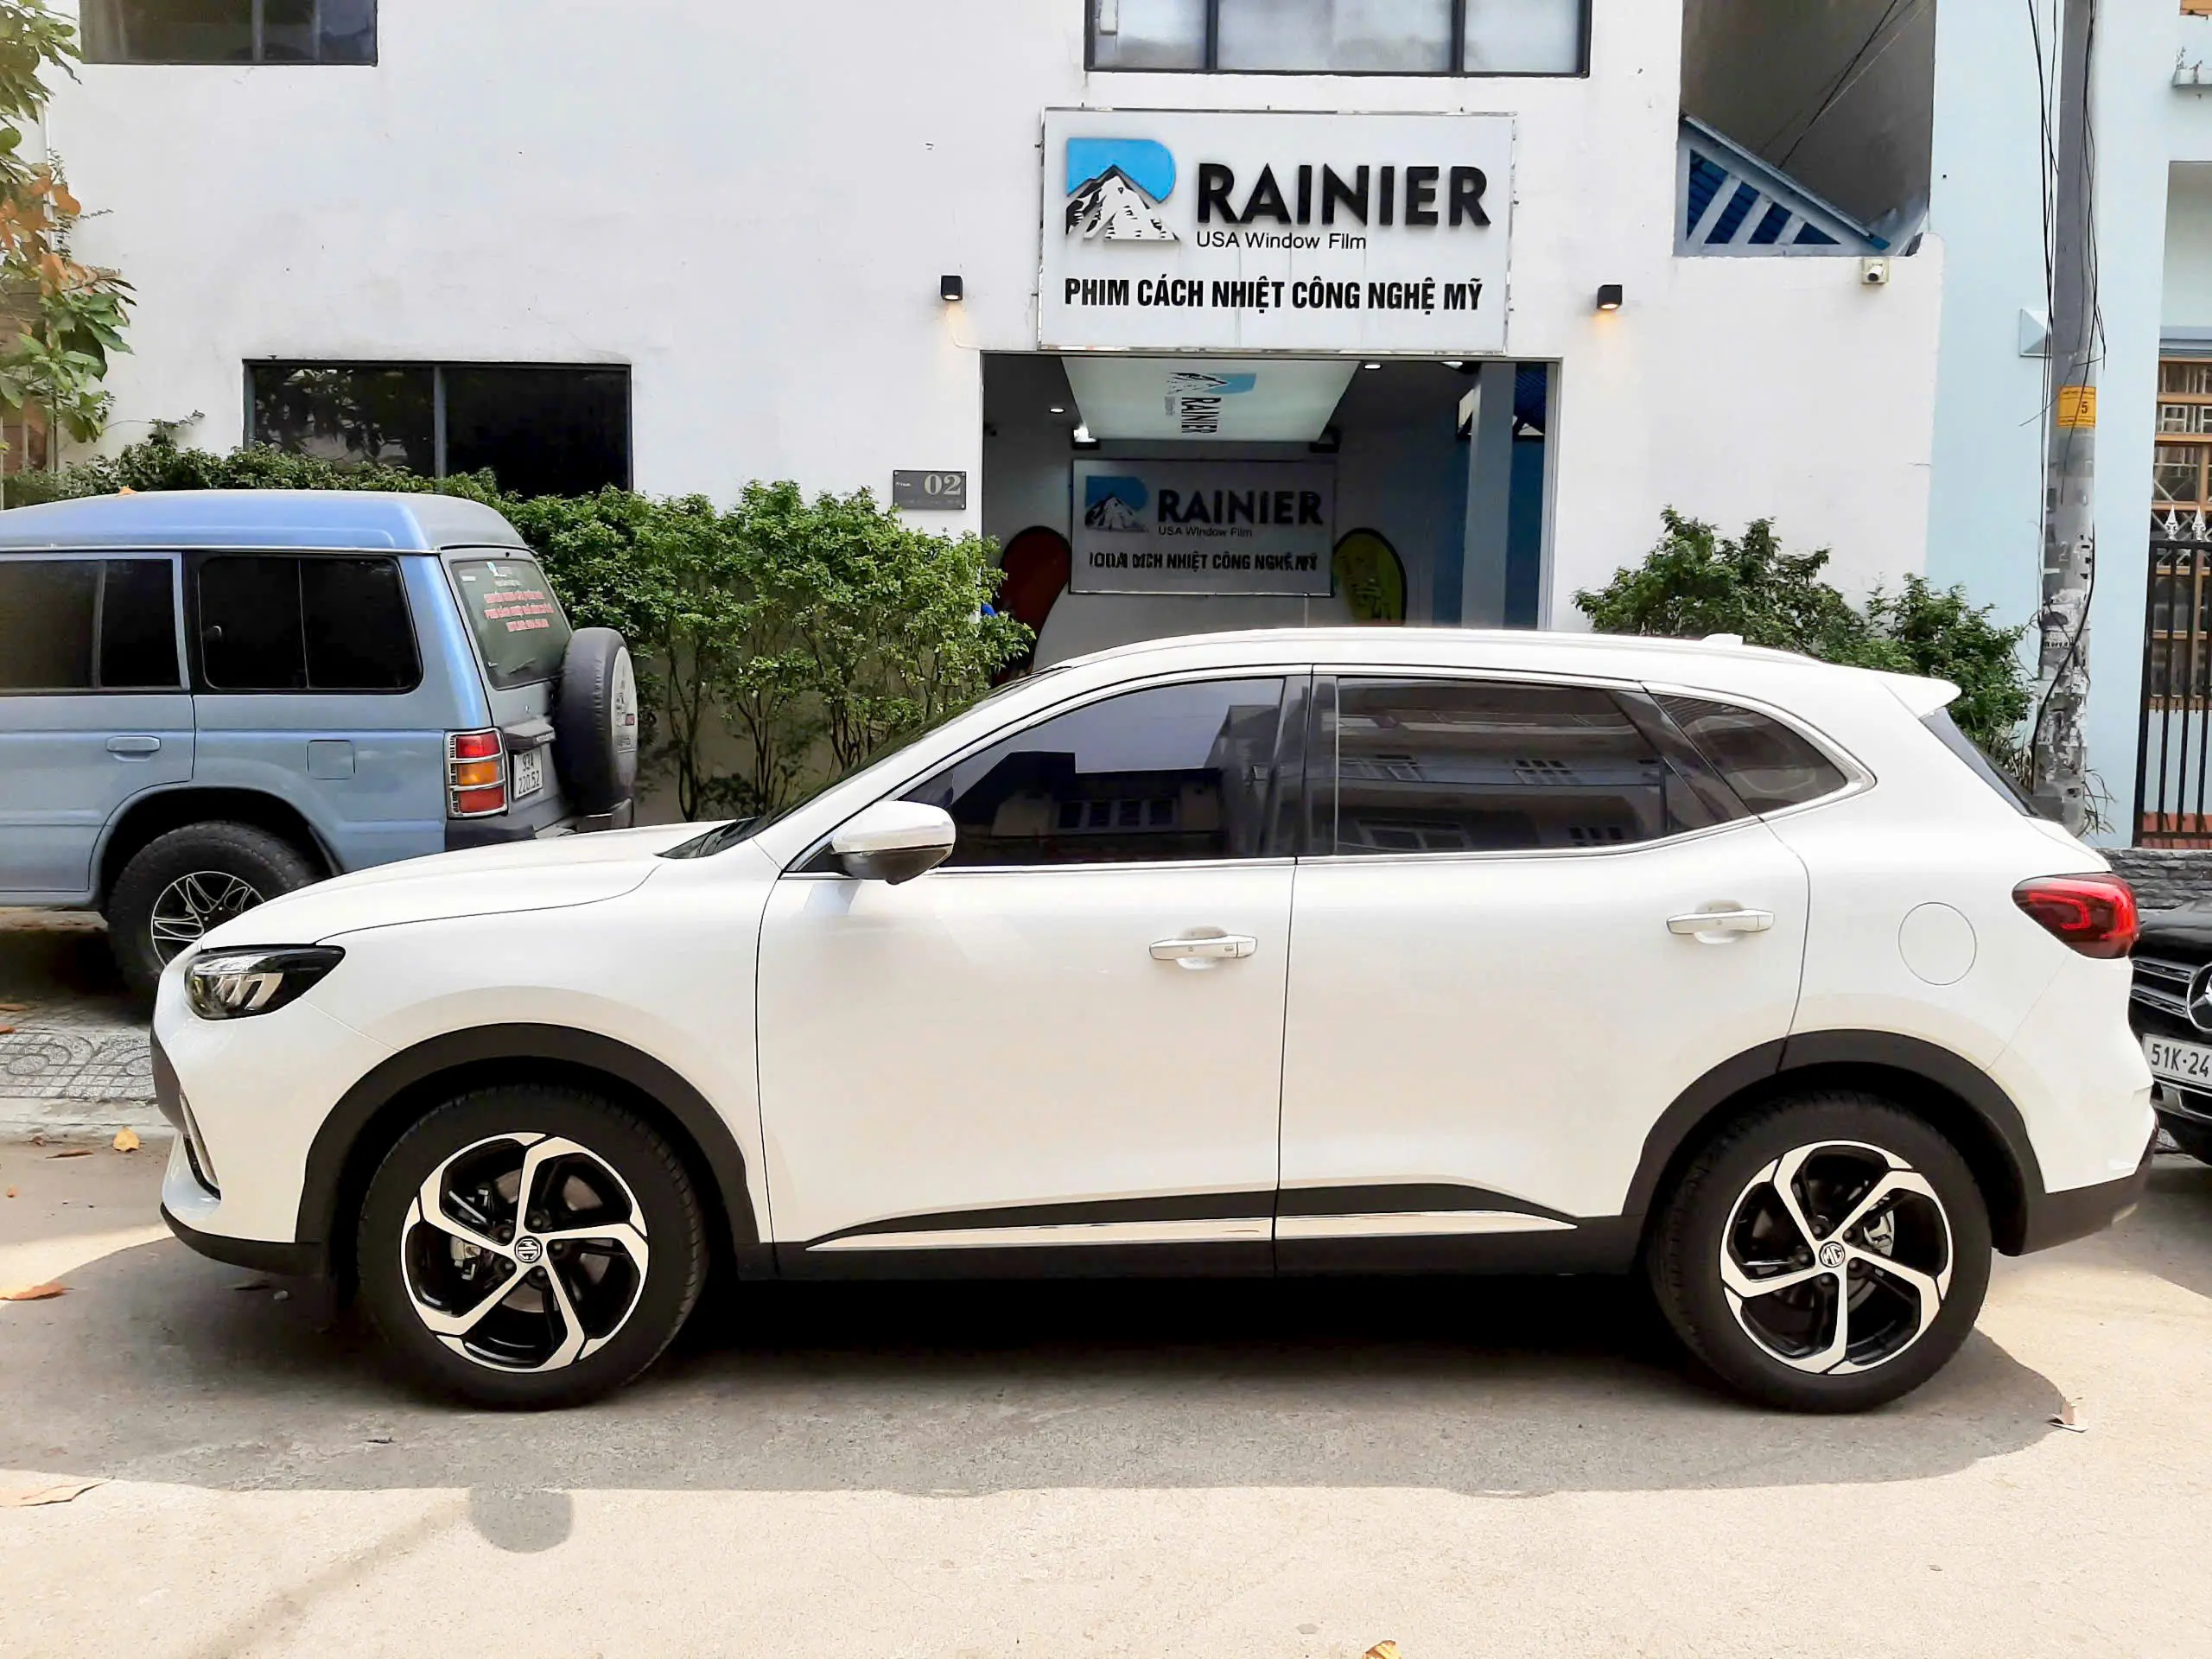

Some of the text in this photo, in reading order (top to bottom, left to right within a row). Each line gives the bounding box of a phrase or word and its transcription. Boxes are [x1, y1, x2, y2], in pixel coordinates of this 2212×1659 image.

[1196, 162, 1491, 227] RAINIER
[1197, 231, 1367, 250] USA Window Film
[1065, 274, 1483, 315] PHIM CÁCH NHIỆT CÔNG NGHỆ MỸ
[1181, 397, 1221, 433] RAINIER
[925, 474, 961, 495] 02
[1158, 489, 1324, 525] RAINIER
[1158, 526, 1252, 537] USA Window Film
[1212, 550, 1250, 571] CÔNG
